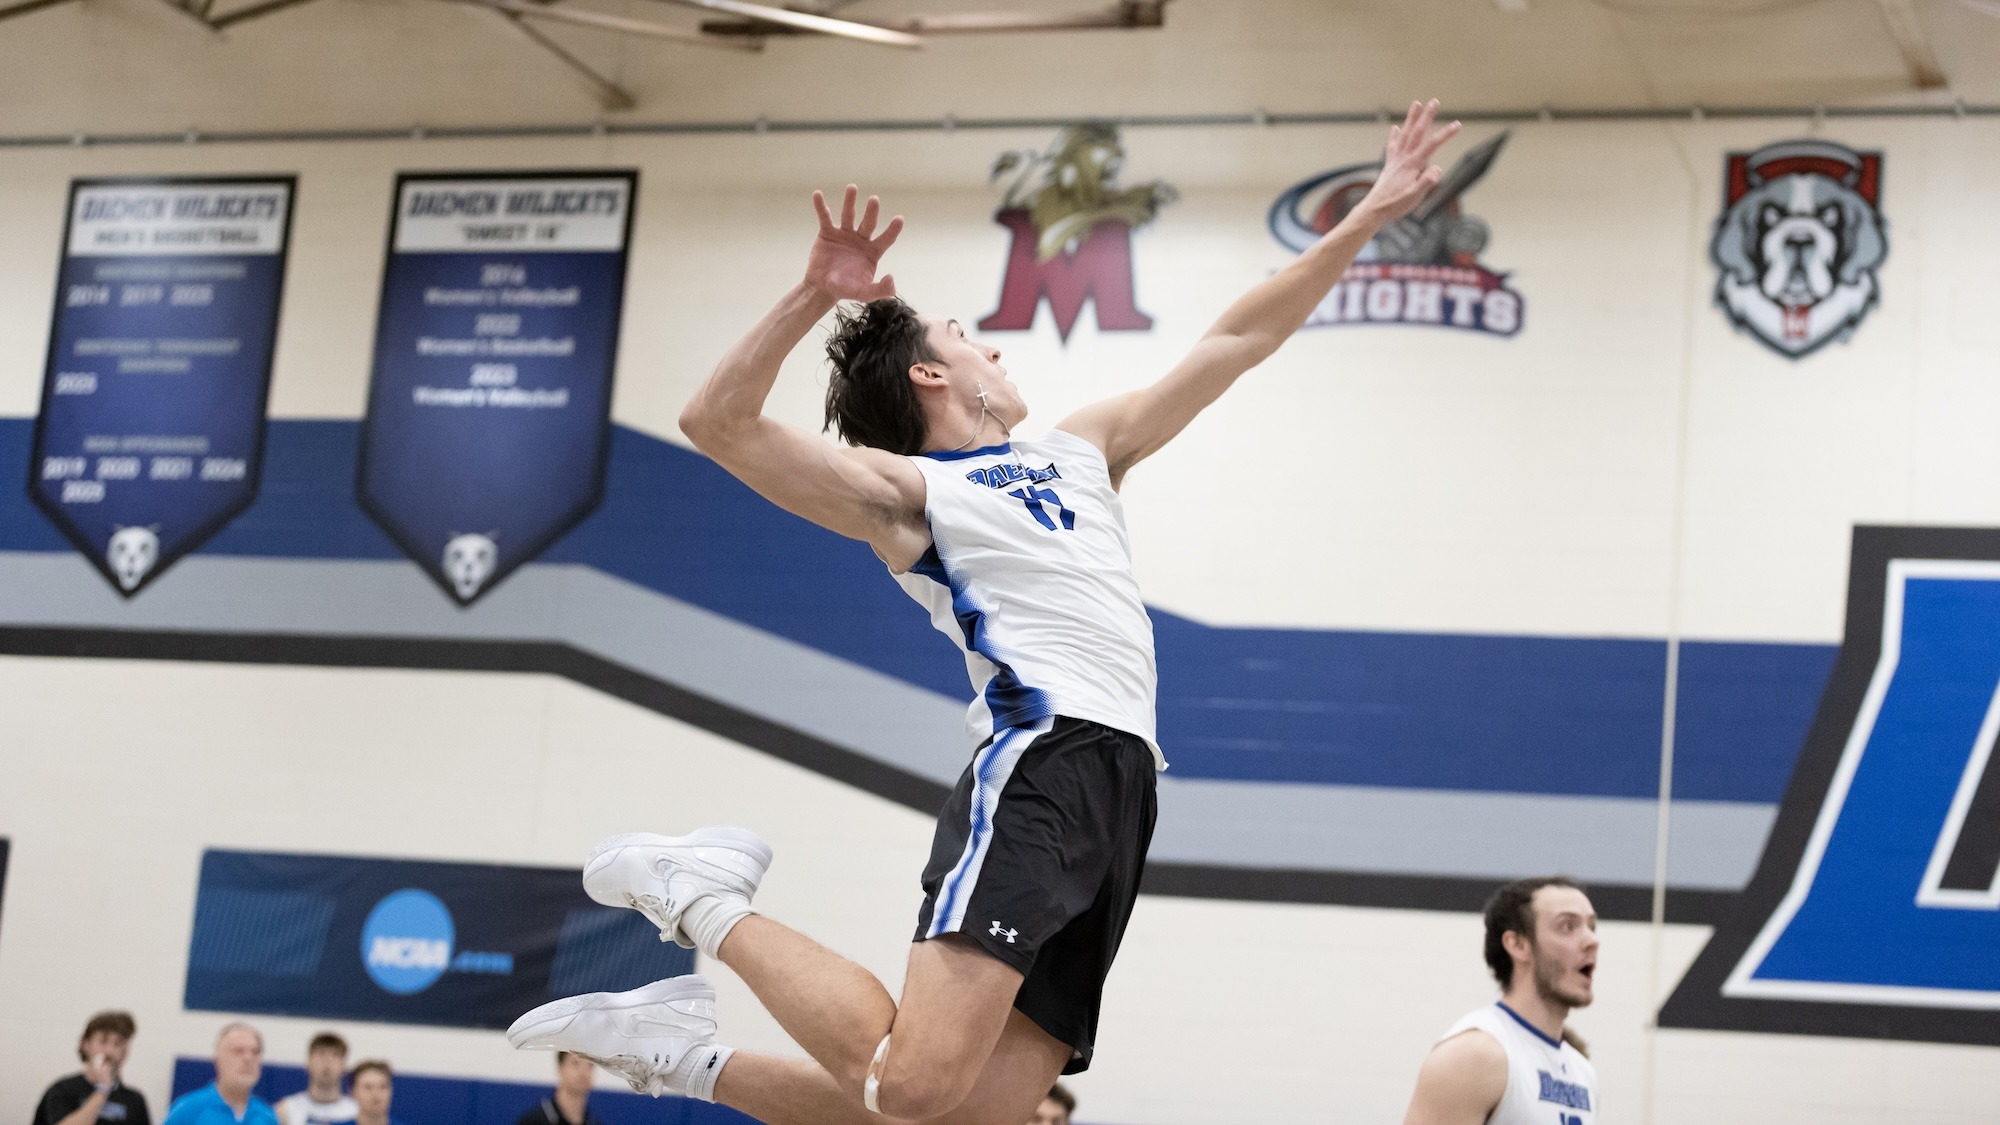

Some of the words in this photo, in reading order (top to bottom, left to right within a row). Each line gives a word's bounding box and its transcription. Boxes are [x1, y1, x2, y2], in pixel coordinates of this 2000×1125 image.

[173, 193, 282, 221] WILDCATS
[408, 191, 497, 217] DAEMEN
[507, 189, 623, 216] WILDCATS
[1303, 278, 1522, 336] NIGHTS
